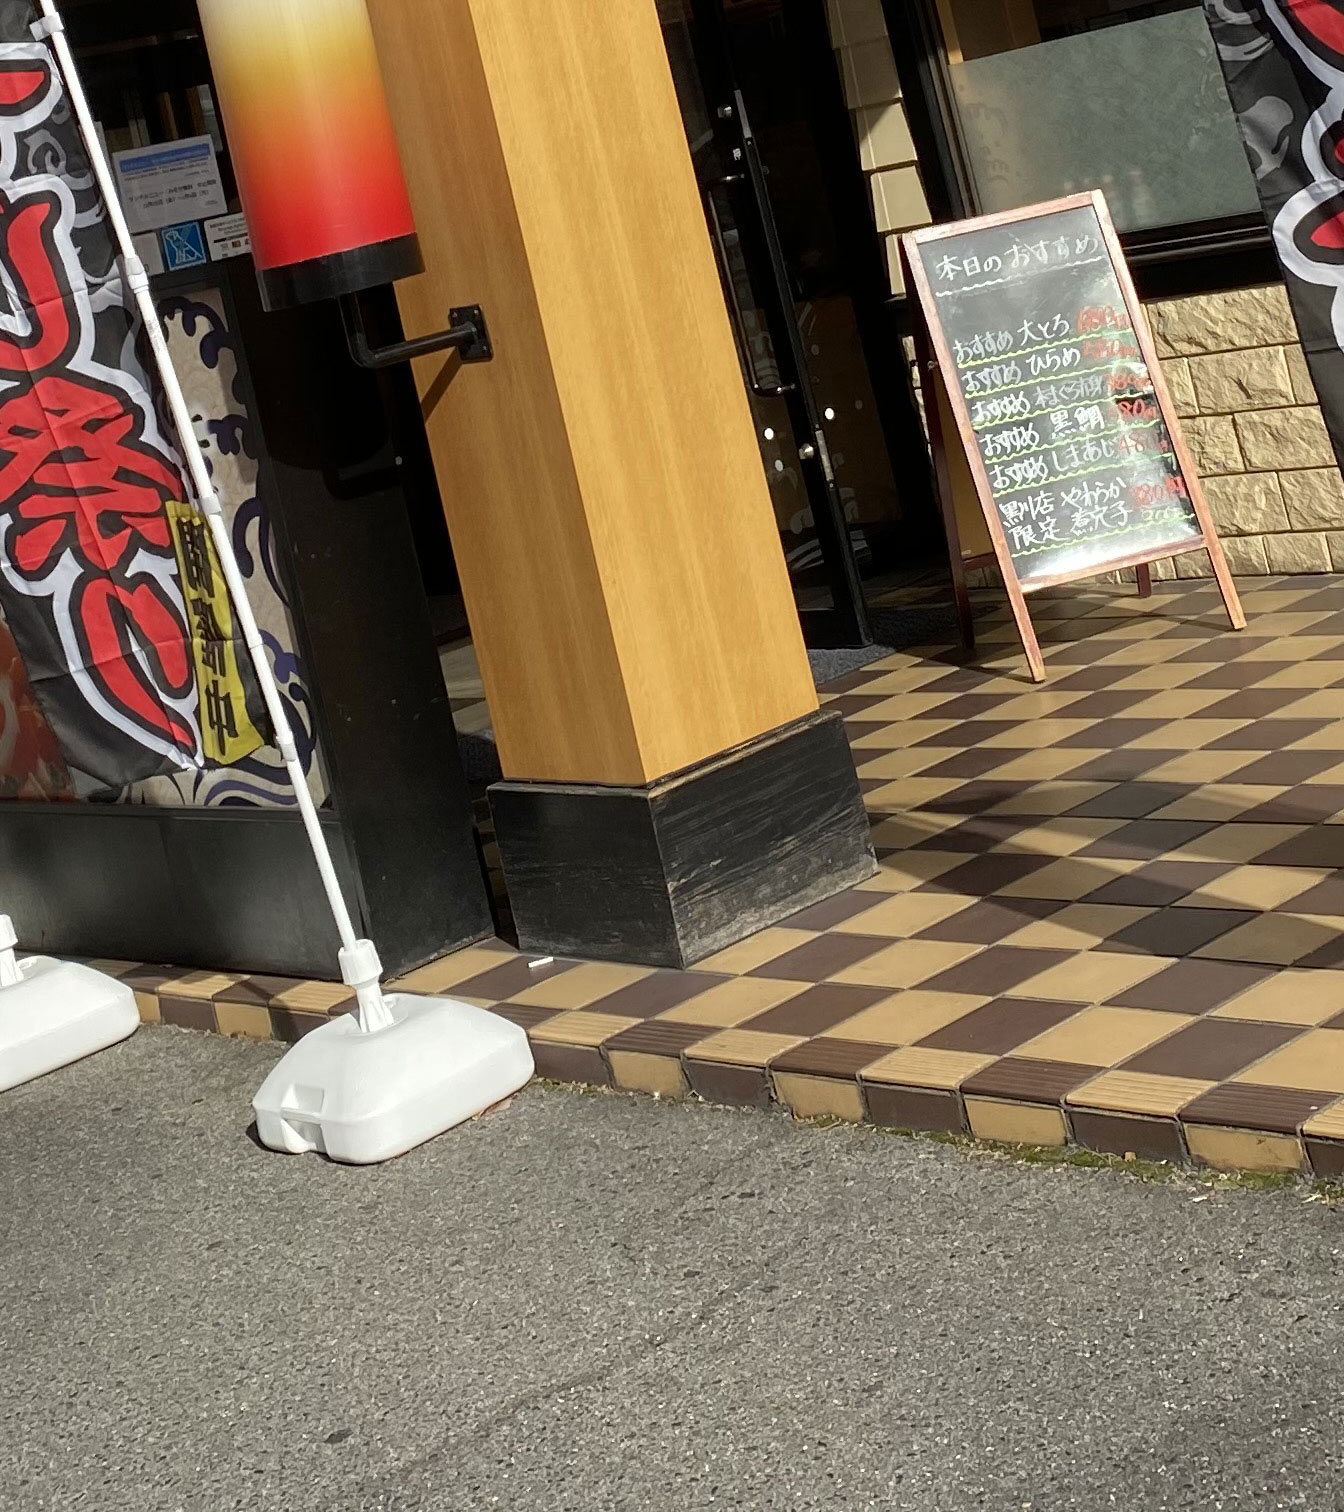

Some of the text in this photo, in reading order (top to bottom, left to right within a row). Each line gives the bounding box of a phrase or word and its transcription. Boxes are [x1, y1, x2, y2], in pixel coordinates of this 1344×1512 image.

[952, 330, 1013, 364] おすすめ
[1017, 313, 1071, 347] 大とろ
[1026, 346, 1081, 376] ひらめ
[1051, 438, 1117, 473] しまあじ
[998, 489, 1056, 528] 黒川店
[1060, 475, 1128, 509] やわらか
[1008, 519, 1069, 552] 限定
